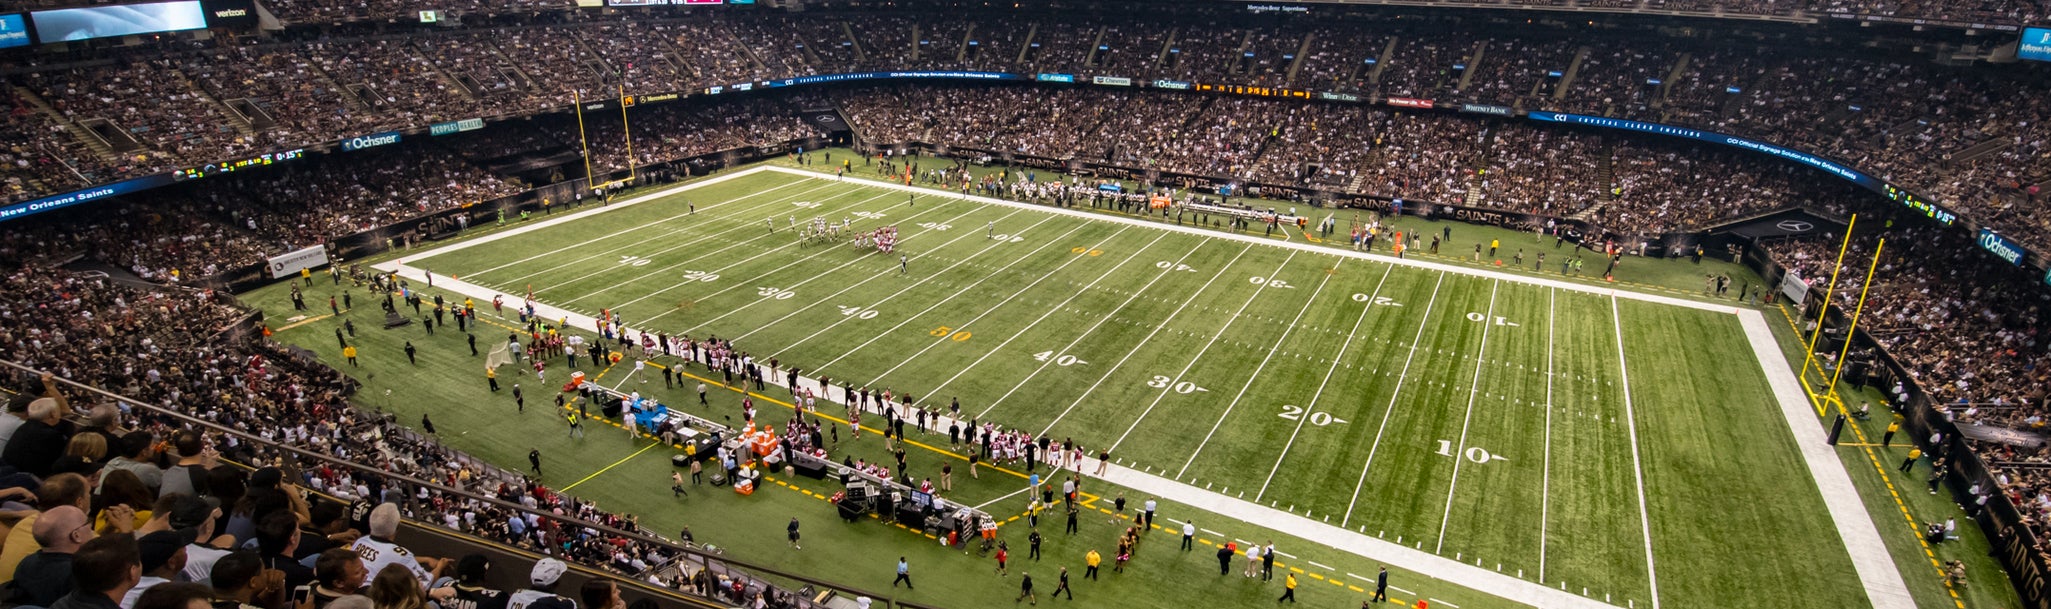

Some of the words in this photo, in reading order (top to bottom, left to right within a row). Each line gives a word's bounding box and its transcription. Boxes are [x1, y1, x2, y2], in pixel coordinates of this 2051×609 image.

[215, 8, 246, 18] verizon
[1158, 80, 1187, 89] Ochsner
[1554, 113, 1568, 122] CCI
[432, 123, 458, 135] PEOPLES
[352, 133, 398, 149] Ochsner
[1097, 167, 1130, 179] SAINTS
[0, 206, 27, 218] New
[29, 196, 76, 211] Orleans
[77, 187, 114, 201] Saints
[1456, 209, 1502, 225] SAINTS
[1984, 233, 2022, 264] Ochsner
[1249, 275, 1288, 289] 30
[759, 286, 796, 301] 30
[1351, 292, 1395, 307] 20
[842, 305, 879, 320] 40
[1466, 311, 1508, 327] 10
[929, 325, 973, 342] 50
[1032, 349, 1078, 367] 40
[1147, 374, 1198, 395] 30
[1277, 404, 1333, 427] 20
[1434, 438, 1491, 464] 10
